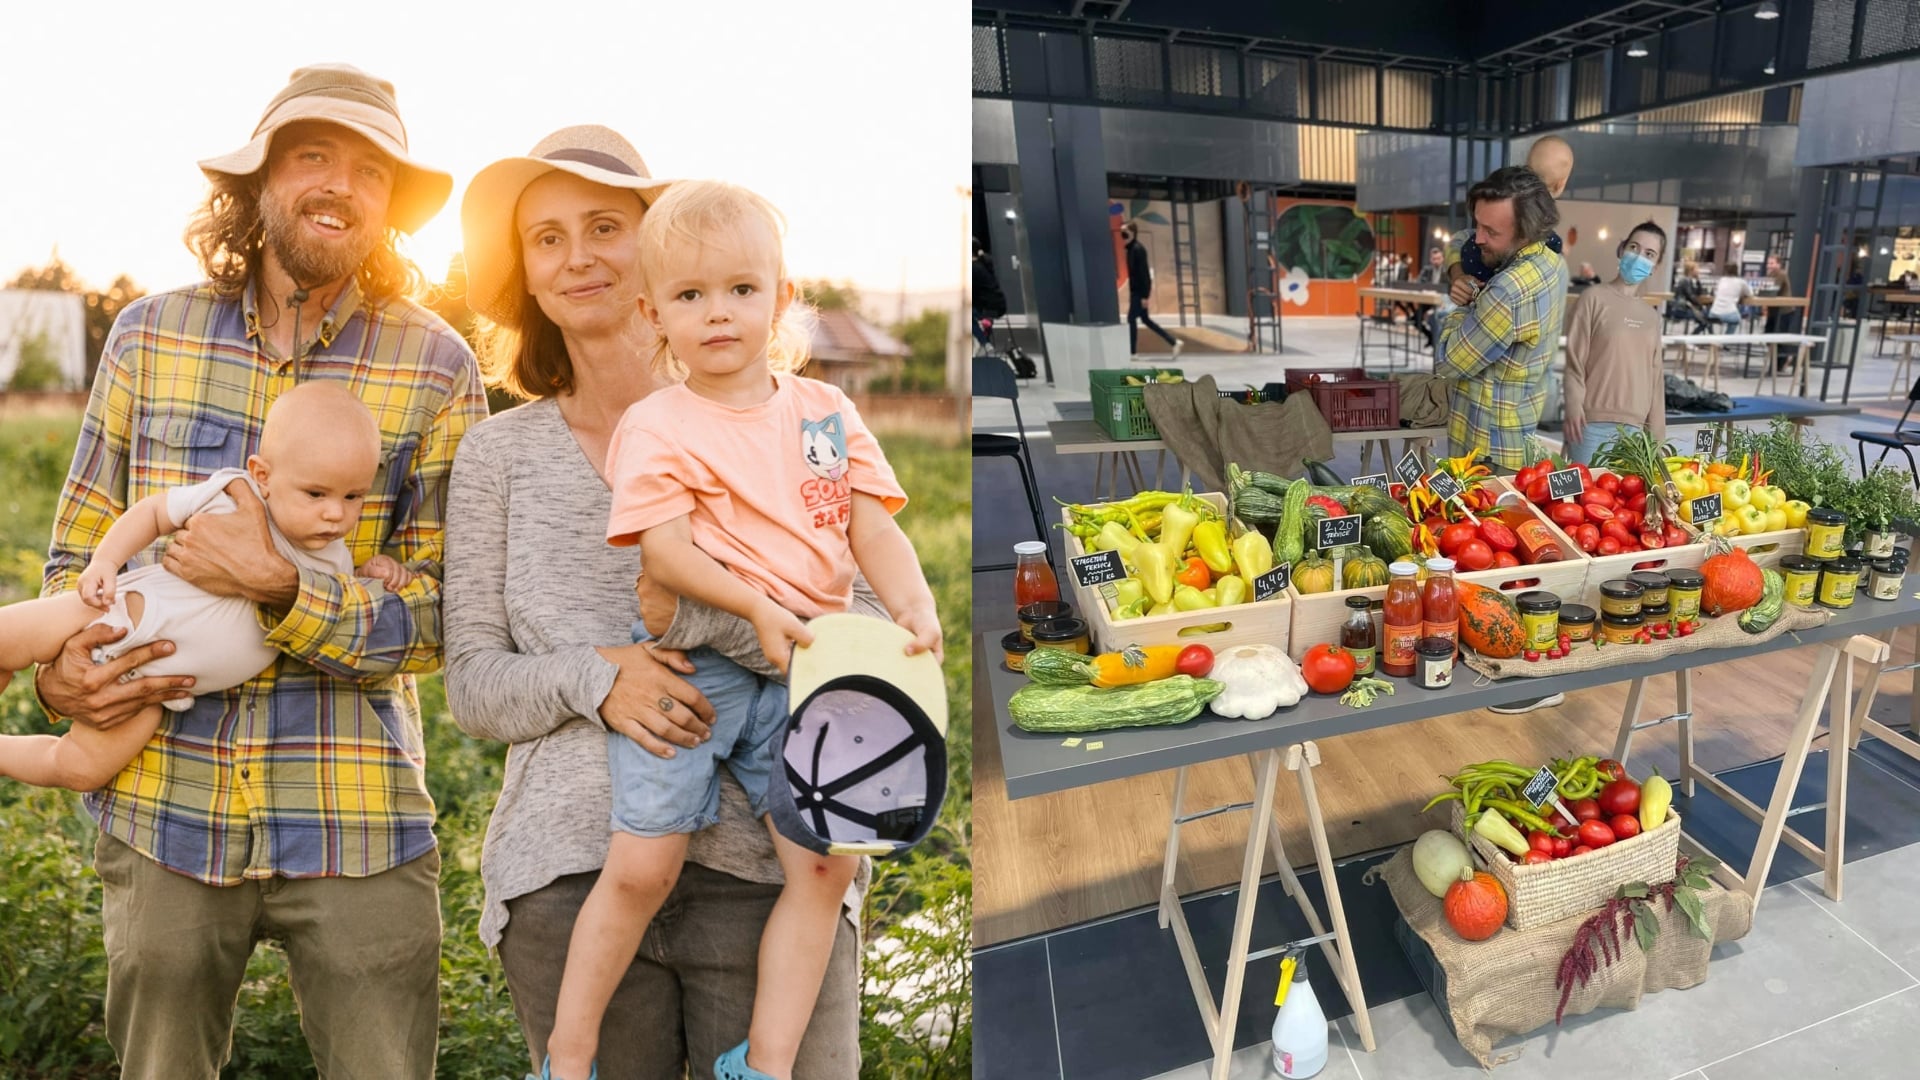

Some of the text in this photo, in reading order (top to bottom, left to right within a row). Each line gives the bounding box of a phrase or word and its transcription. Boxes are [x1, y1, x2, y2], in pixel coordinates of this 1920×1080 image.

[1551, 473, 1573, 486] 4,40
[1693, 499, 1715, 515] 4,40
[1325, 520, 1354, 533] 2,20
[1258, 572, 1284, 591] 4,40
